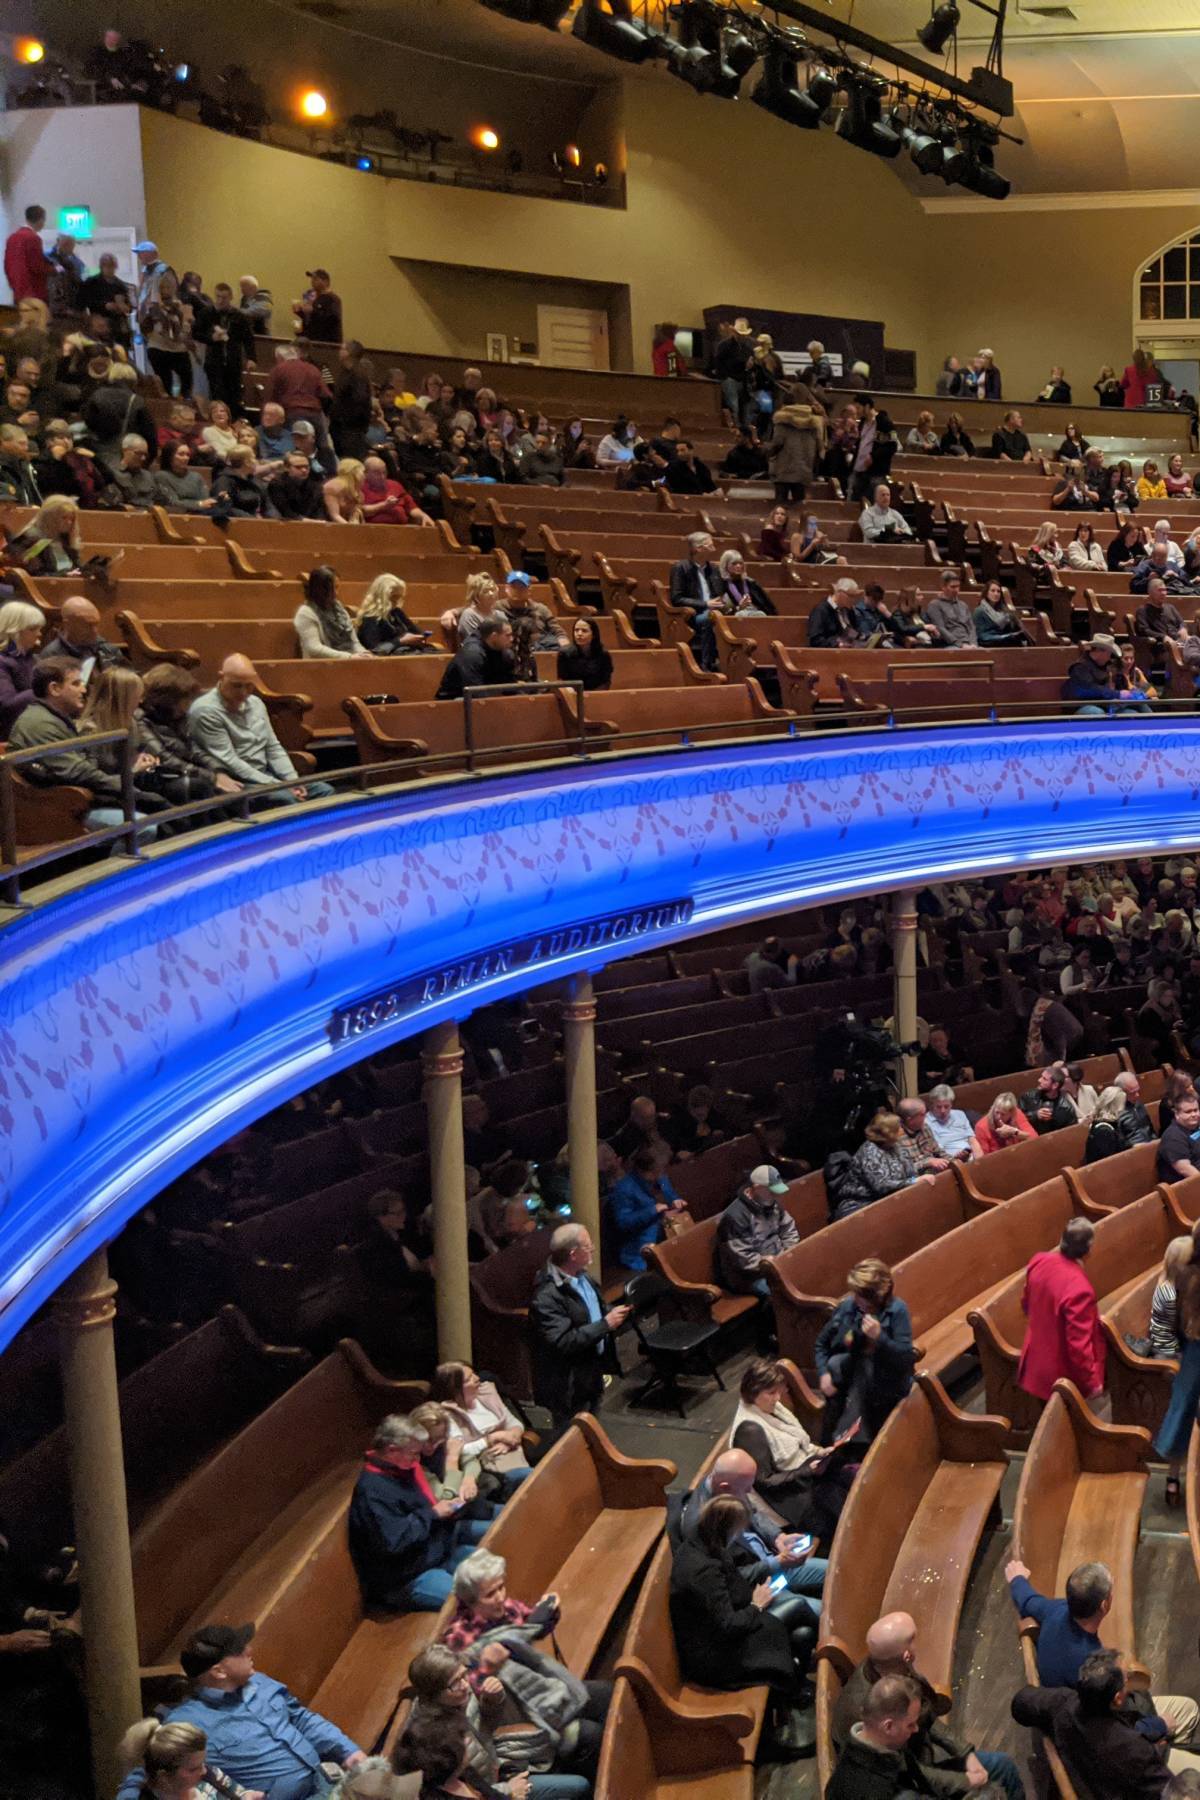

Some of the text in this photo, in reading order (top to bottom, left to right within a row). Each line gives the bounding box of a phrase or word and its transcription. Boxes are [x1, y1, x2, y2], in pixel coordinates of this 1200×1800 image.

[1149, 389, 1161, 401] 15
[339, 903, 691, 1041] 1892 RYMAN AUDITORIUM
